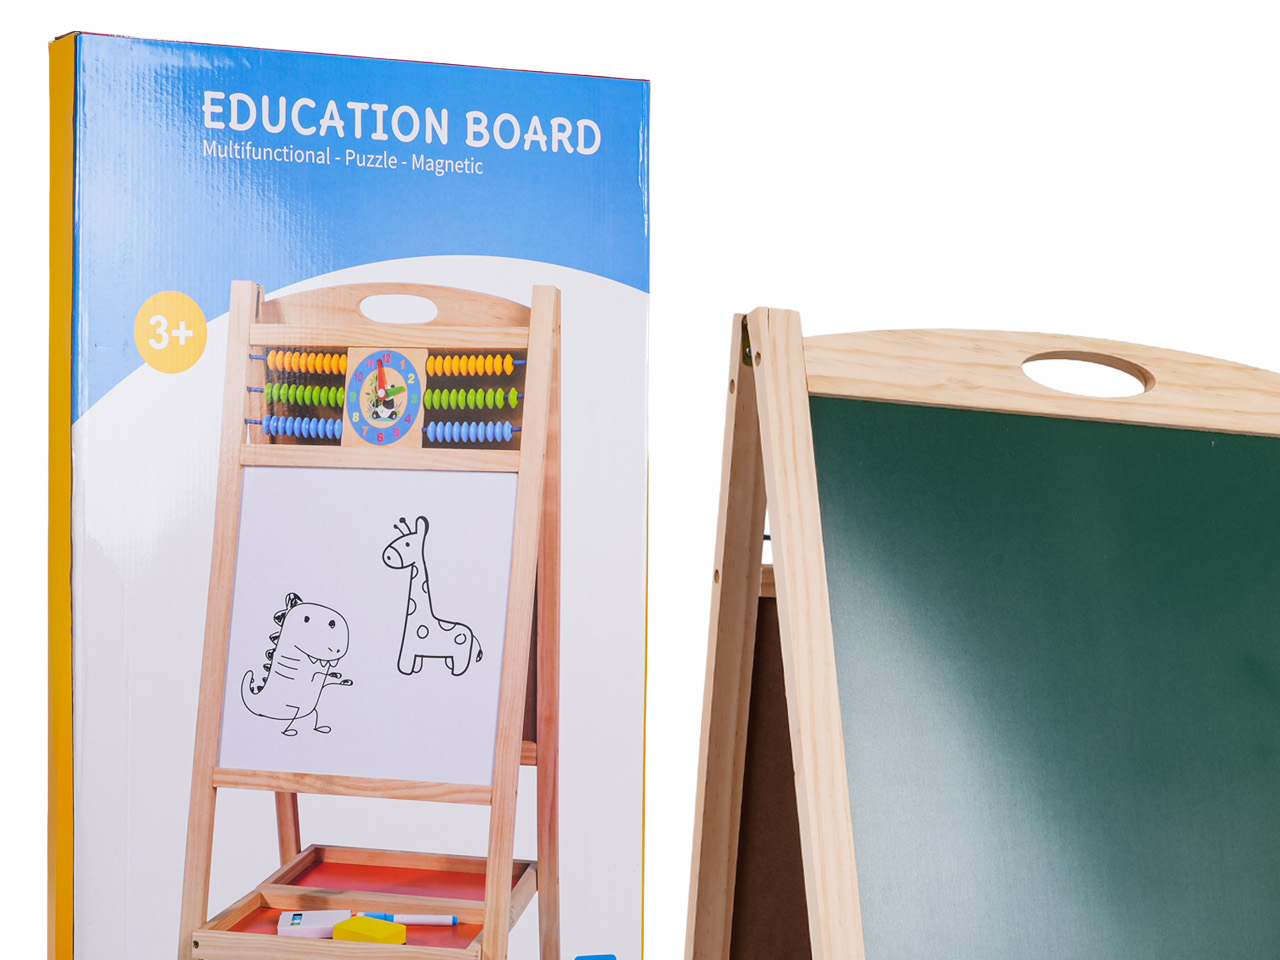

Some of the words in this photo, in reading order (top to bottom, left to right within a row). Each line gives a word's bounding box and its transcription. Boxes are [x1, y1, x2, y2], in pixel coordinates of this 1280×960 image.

[202, 90, 448, 145] EDUCATION
[465, 111, 601, 155] BOARD
[203, 140, 330, 165] Multifunctional
[345, 150, 397, 169] Puzzle
[412, 154, 483, 177] Magnetic
[148, 315, 193, 350] 3+
[383, 353, 391, 363] 12
[366, 359, 373, 368] 11
[400, 360, 405, 369] 1
[355, 372, 363, 381] 10
[408, 374, 415, 383] 2
[350, 392, 356, 401] 9
[411, 394, 417, 403] 3
[353, 413, 359, 421] 8
[405, 414, 411, 423] 4
[362, 426, 368, 436] 7
[394, 427, 400, 437] 5
[377, 433, 384, 442] 6
